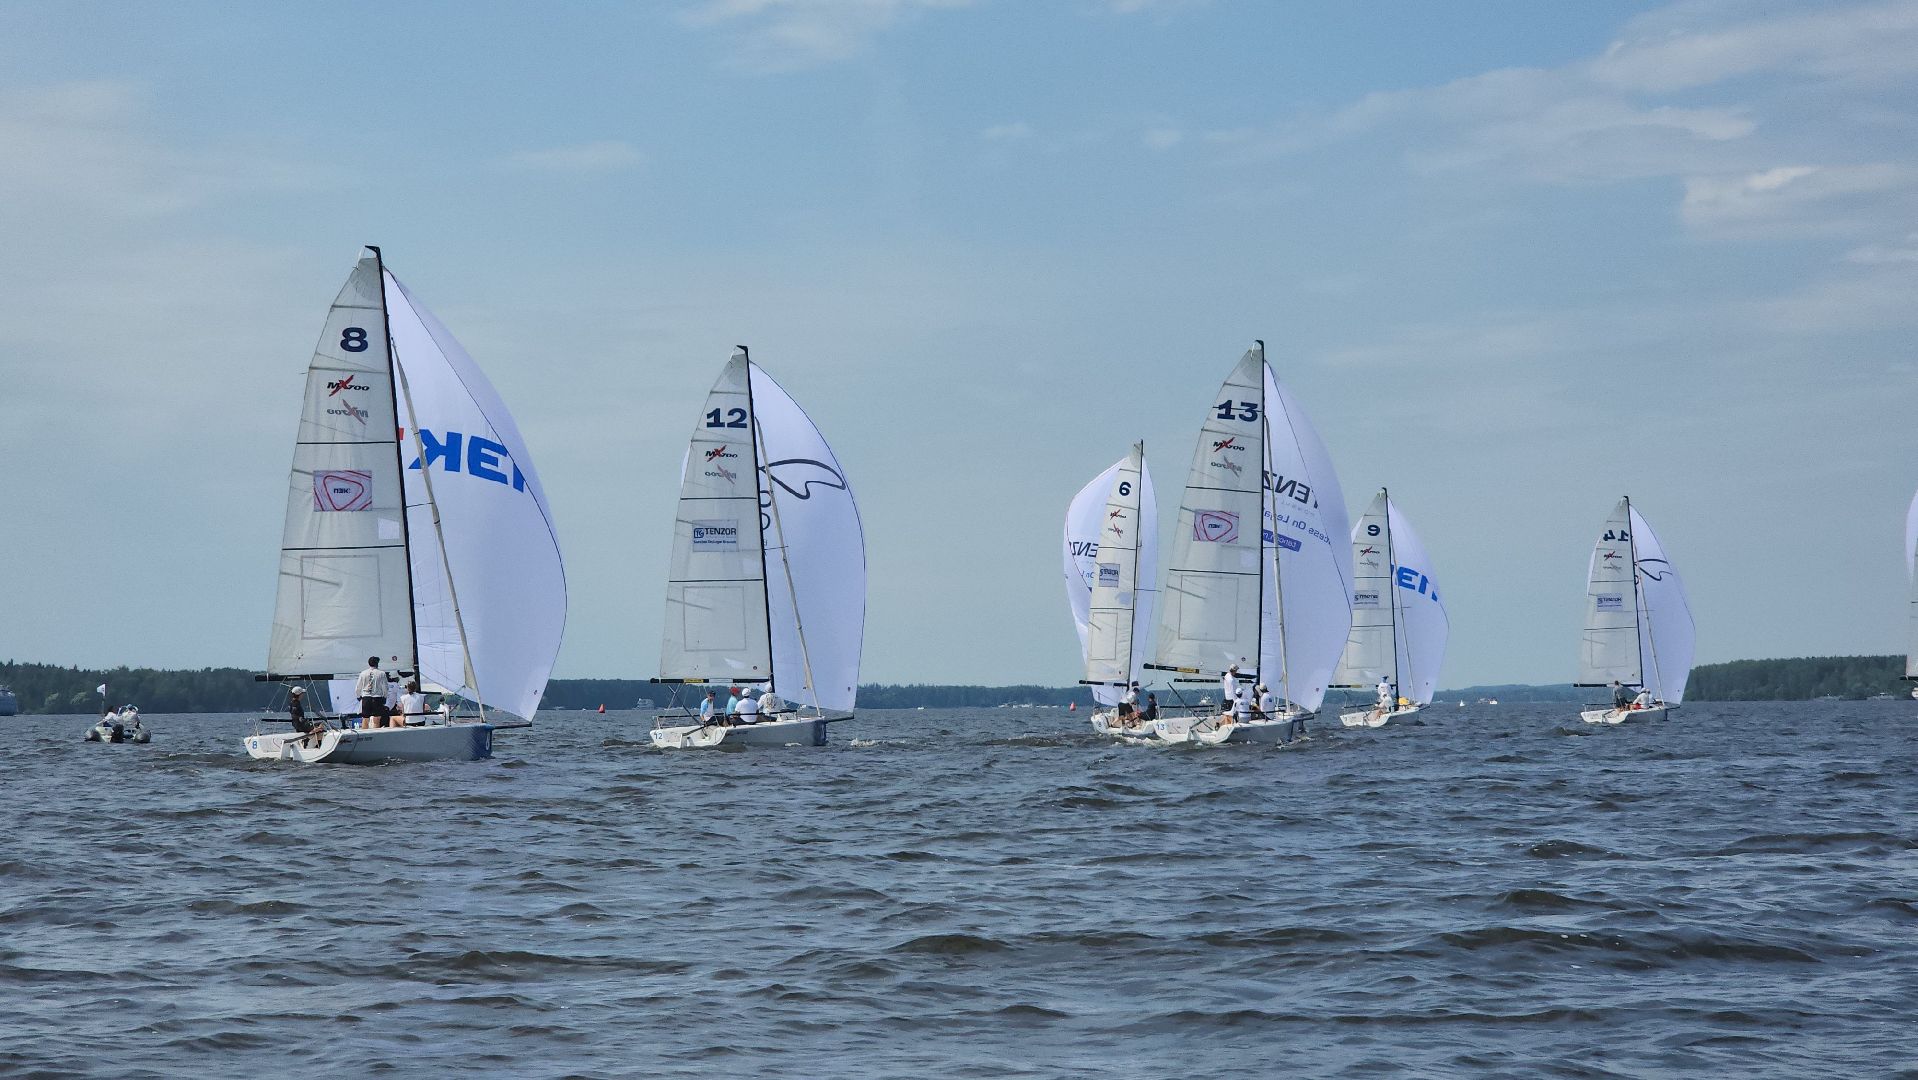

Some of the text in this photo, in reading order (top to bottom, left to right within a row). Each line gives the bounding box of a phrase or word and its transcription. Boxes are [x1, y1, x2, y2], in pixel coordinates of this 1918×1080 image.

[340, 327, 369, 352] 8
[1217, 400, 1258, 422] 13
[706, 408, 748, 429] 12
[1119, 481, 1132, 496] 6
[1367, 524, 1381, 537] 9
[1157, 723, 1165, 731] 13
[654, 732, 663, 740] 12
[252, 740, 258, 750] 8
